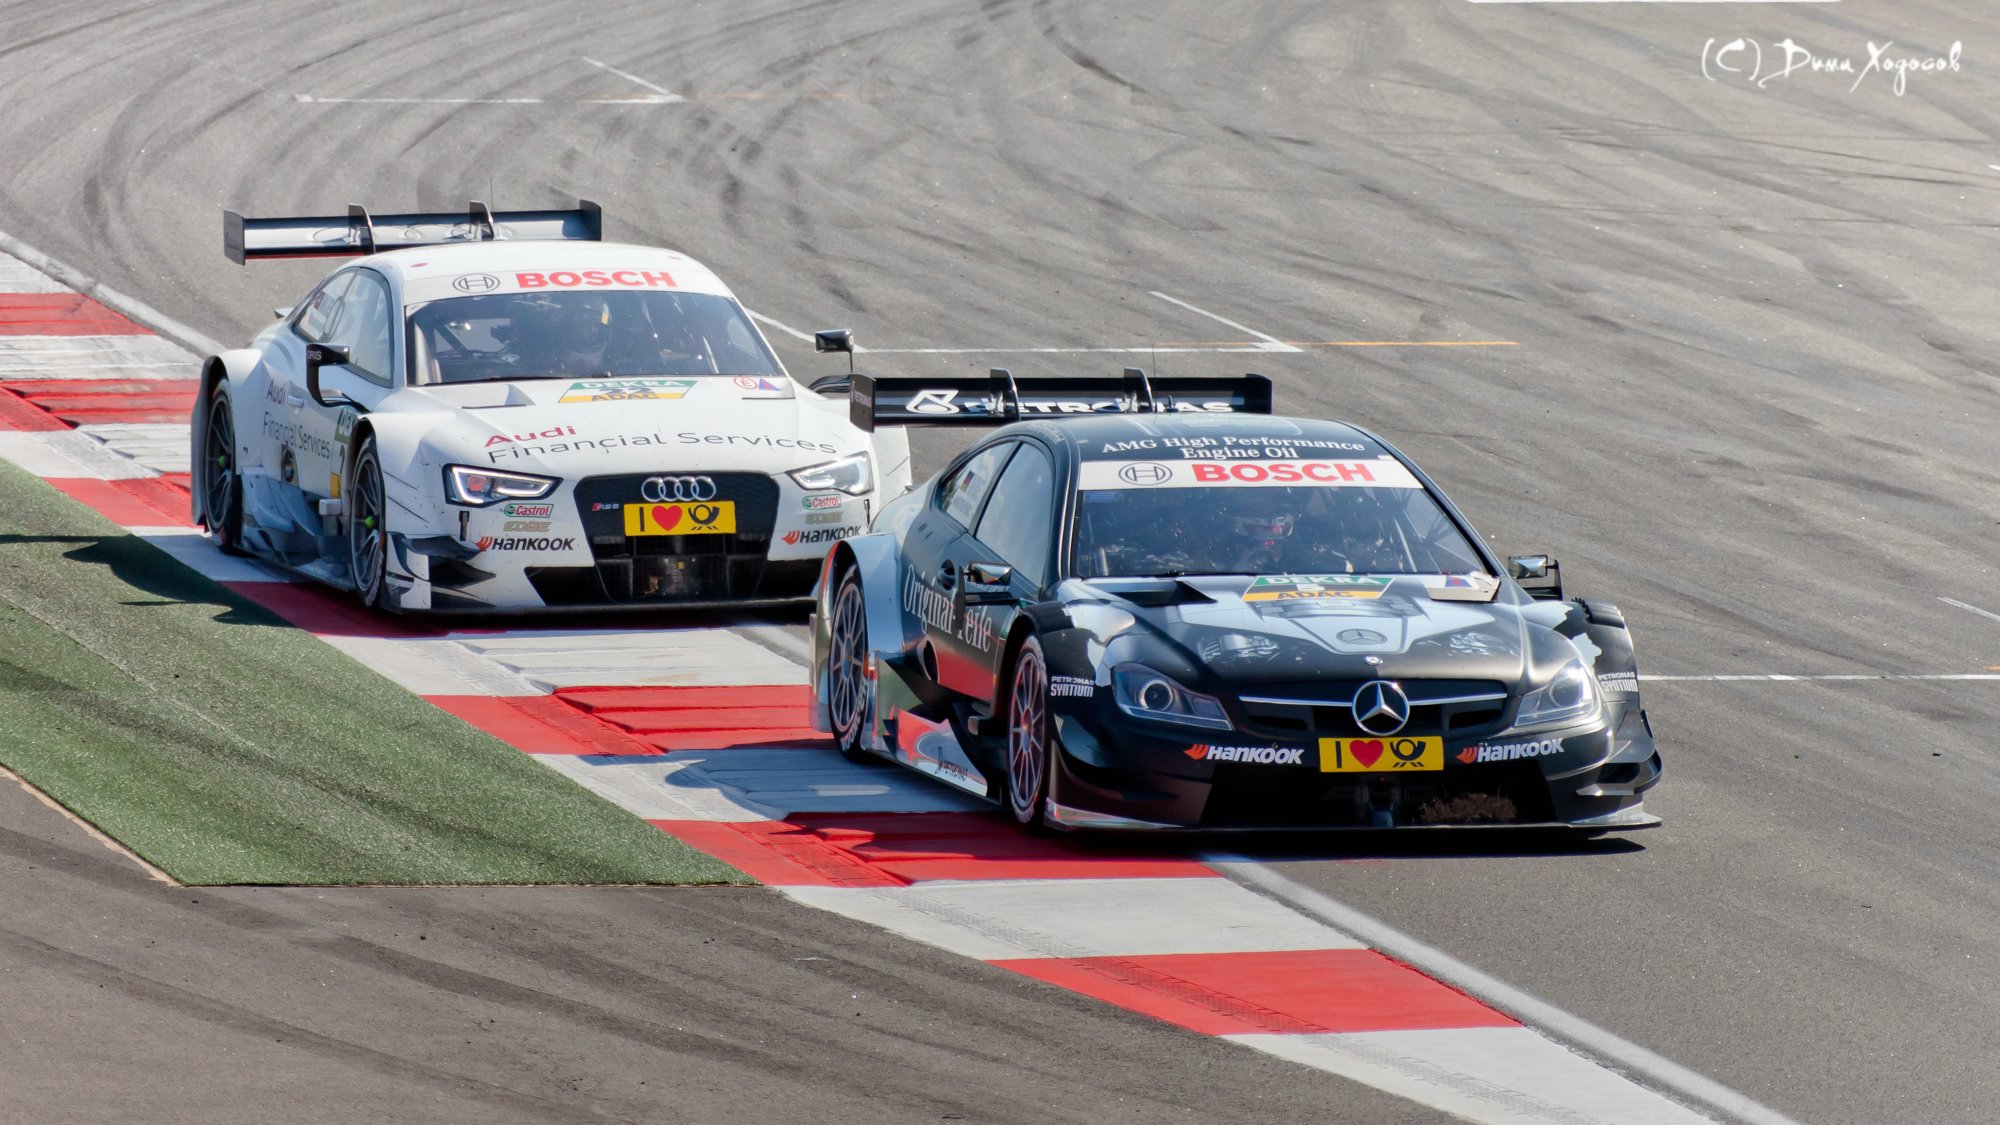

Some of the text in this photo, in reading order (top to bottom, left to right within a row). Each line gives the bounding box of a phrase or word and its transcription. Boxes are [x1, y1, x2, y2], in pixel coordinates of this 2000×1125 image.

[515, 271, 678, 288] BOSCH
[580, 380, 684, 389] DEKRA
[591, 393, 661, 401] ADAC
[484, 426, 577, 448] Audi
[488, 431, 838, 464] Financial Services
[1101, 436, 1366, 453] AMG High Performance
[1182, 446, 1300, 461] Engine Oil
[1190, 463, 1376, 483] BOSCH
[812, 496, 840, 508] Castrol
[514, 505, 550, 517] Castrol
[1265, 576, 1383, 585] DEKRA
[1276, 591, 1355, 600] ADAC
[1597, 671, 1636, 681] PETRONAS
